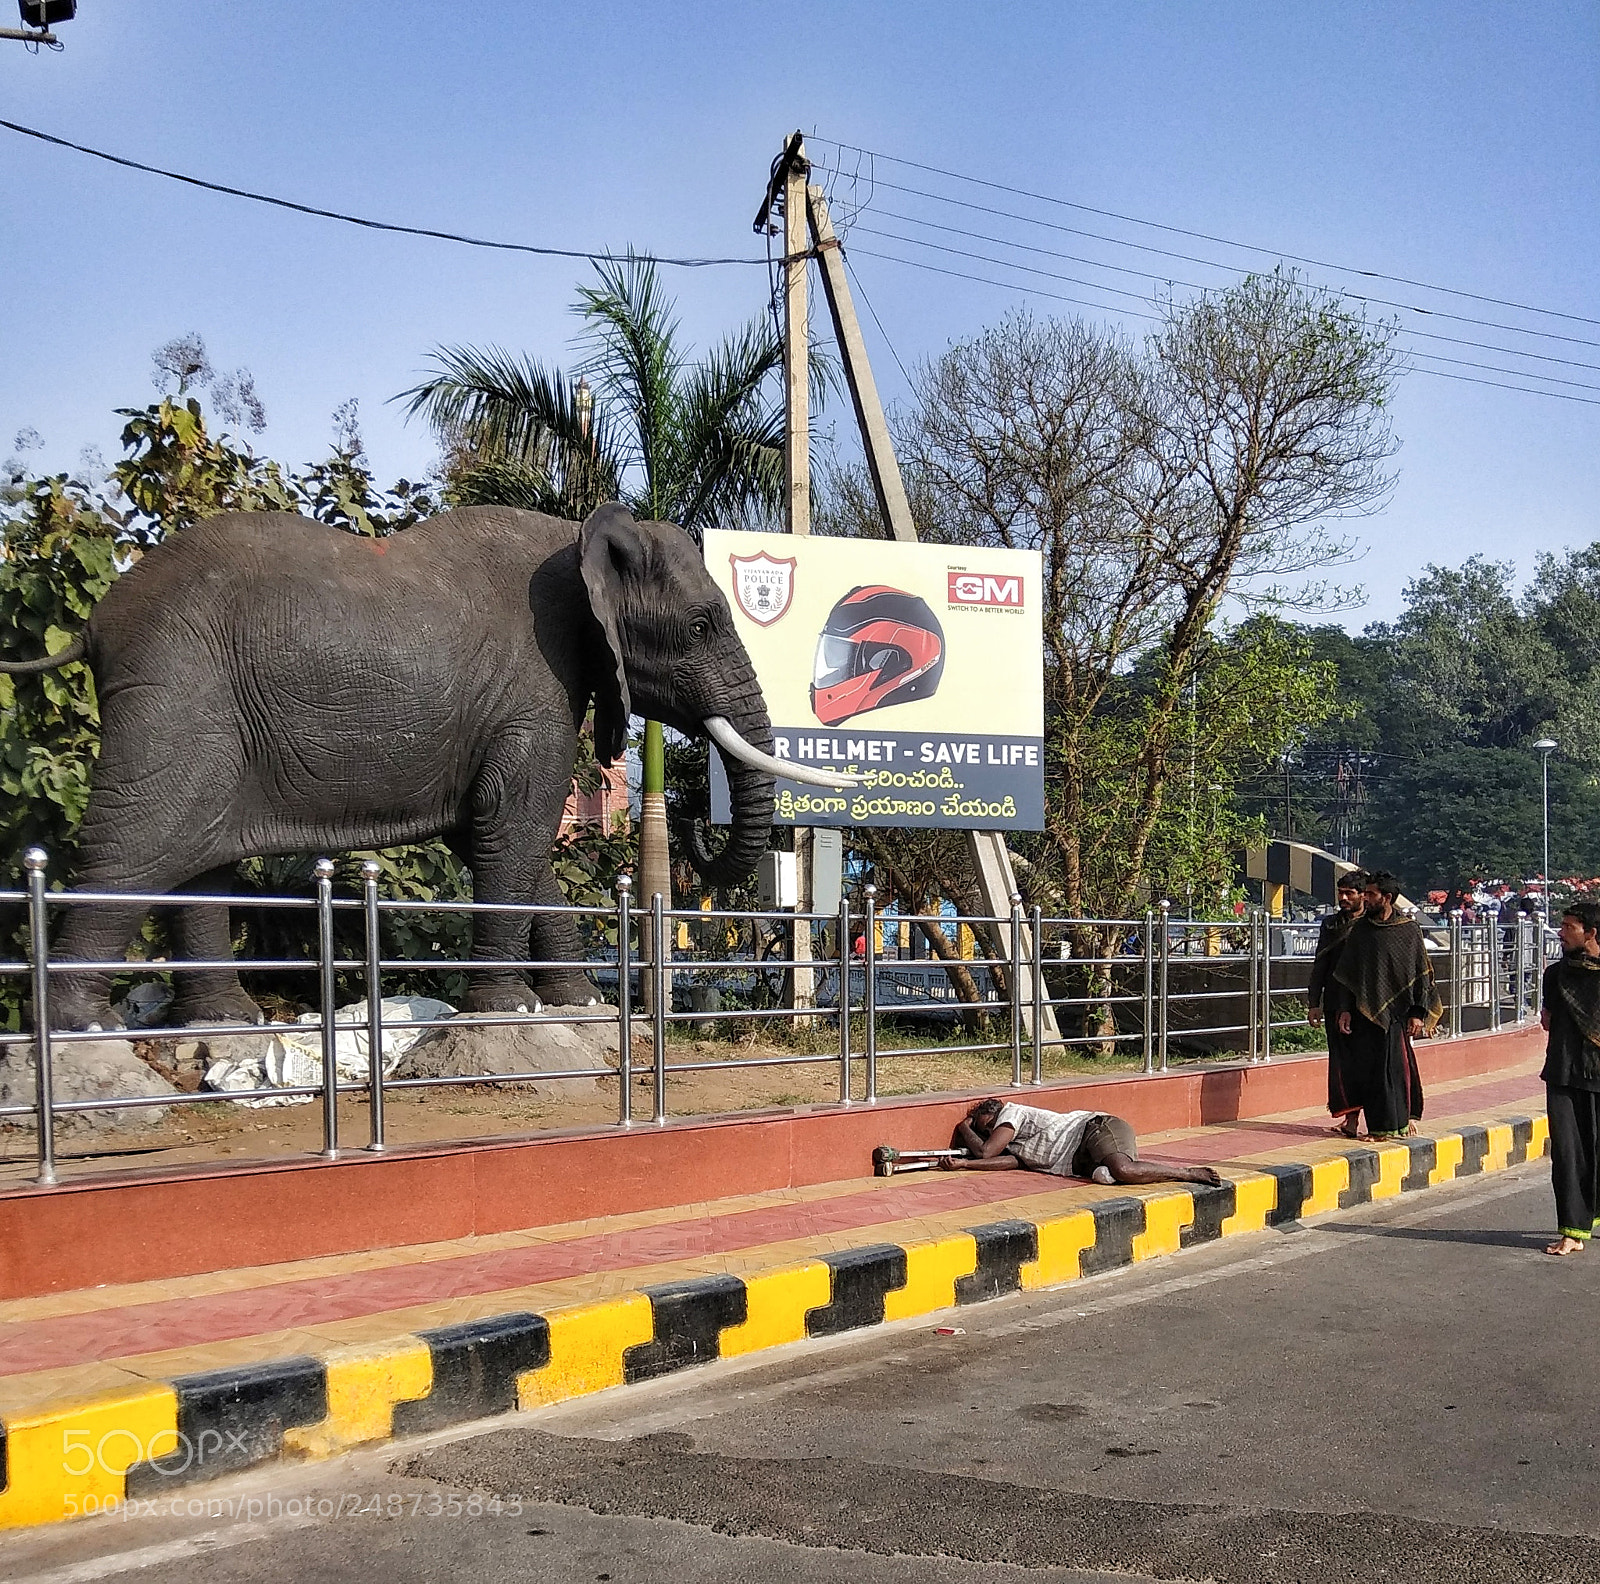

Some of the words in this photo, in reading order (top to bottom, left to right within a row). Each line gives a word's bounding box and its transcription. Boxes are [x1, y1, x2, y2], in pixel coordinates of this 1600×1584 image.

[744, 574, 784, 585] POLICE
[950, 576, 1019, 604] GM
[798, 737, 897, 762] HELMET
[919, 741, 981, 764] SAVE
[987, 744, 1039, 766] LIFE
[850, 794, 936, 820] ప్రయాణం
[940, 792, 1017, 817] చేయండి
